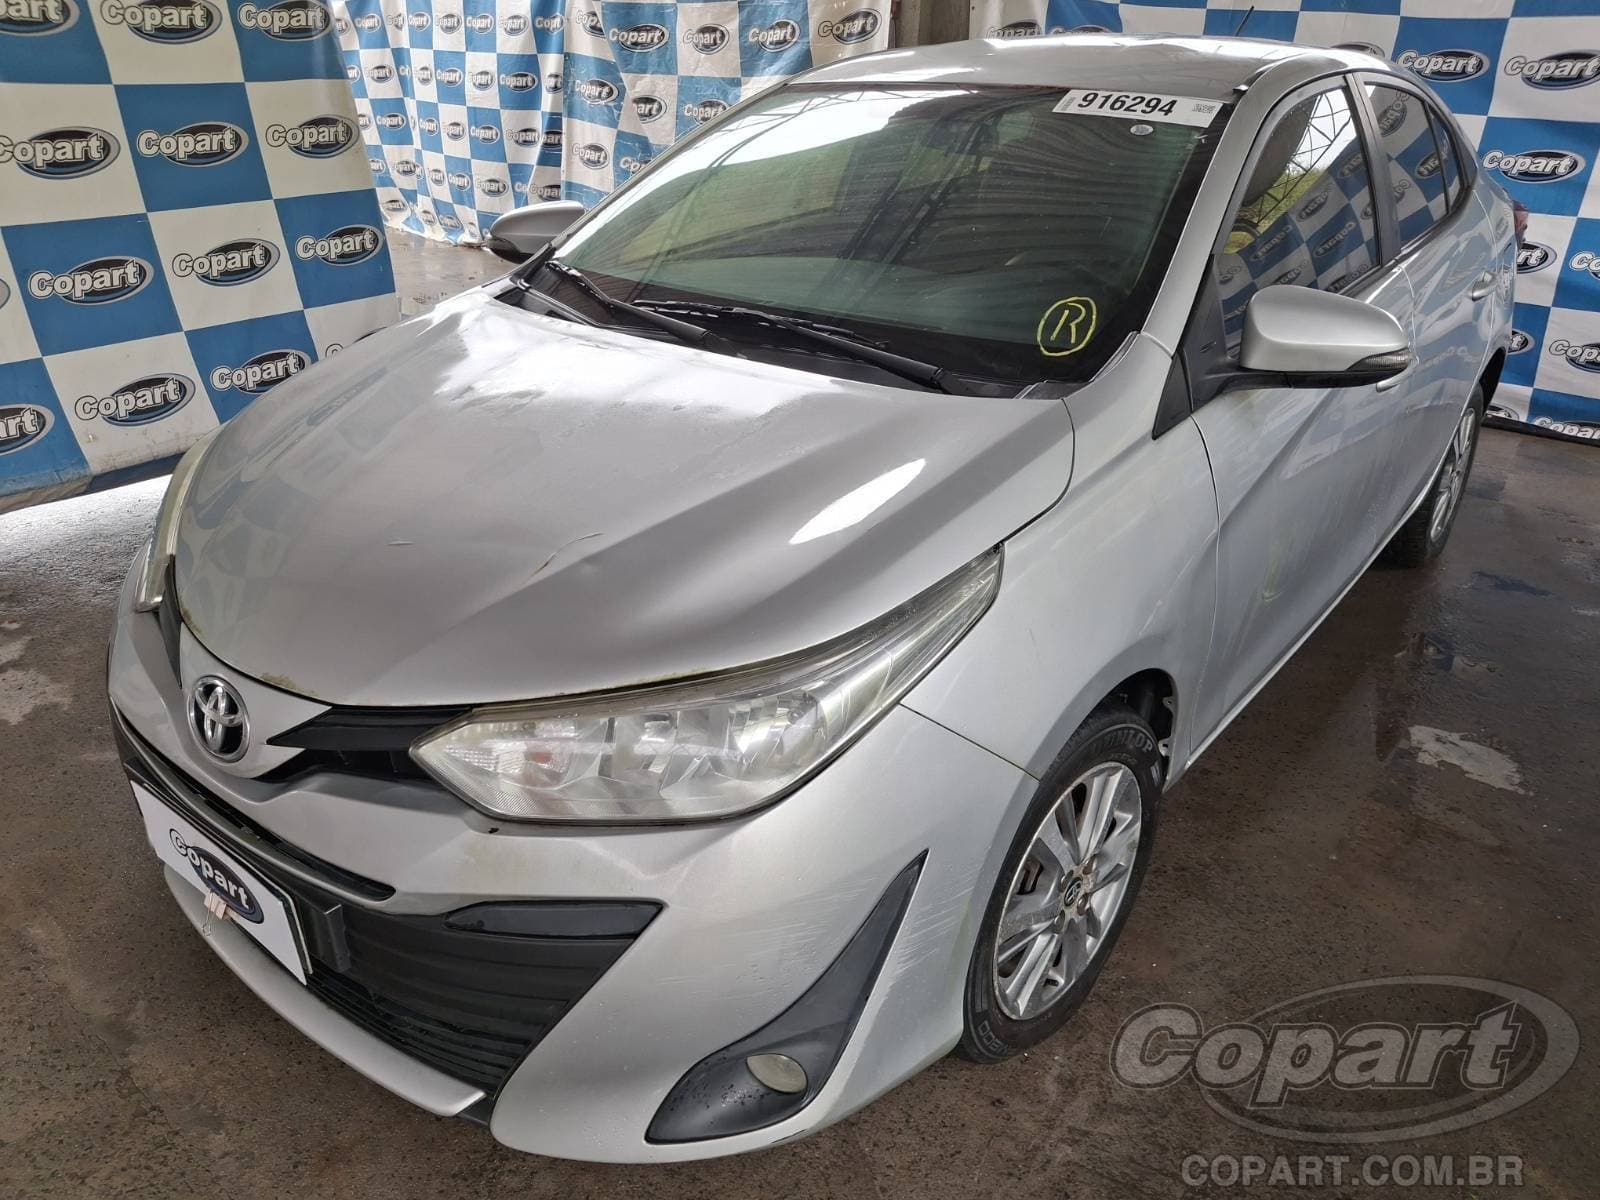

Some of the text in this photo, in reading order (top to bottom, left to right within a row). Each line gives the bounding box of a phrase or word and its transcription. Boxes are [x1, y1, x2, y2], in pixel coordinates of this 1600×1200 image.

[101, 0, 207, 33] Copart
[239, 1, 326, 33] Copart
[817, 13, 874, 38] Copart
[609, 27, 662, 46] Copart
[683, 29, 722, 47] Copart
[748, 24, 794, 48] Copart
[1397, 50, 1482, 77] Copart
[1504, 54, 1600, 84] Copart
[500, 74, 533, 88] Copart
[575, 80, 610, 98] Copart
[1078, 92, 1178, 116] 916294
[138, 127, 235, 158] Copart
[266, 121, 348, 148] Copart
[470, 127, 497, 140] Copart
[573, 143, 605, 160] Copart
[1483, 150, 1576, 177] Copart
[295, 227, 375, 261] Copart
[172, 243, 266, 280] Copart
[29, 260, 140, 299] Copart
[210, 349, 300, 391] Copart
[75, 376, 181, 420] Copart
[169, 828, 250, 909] Copart
